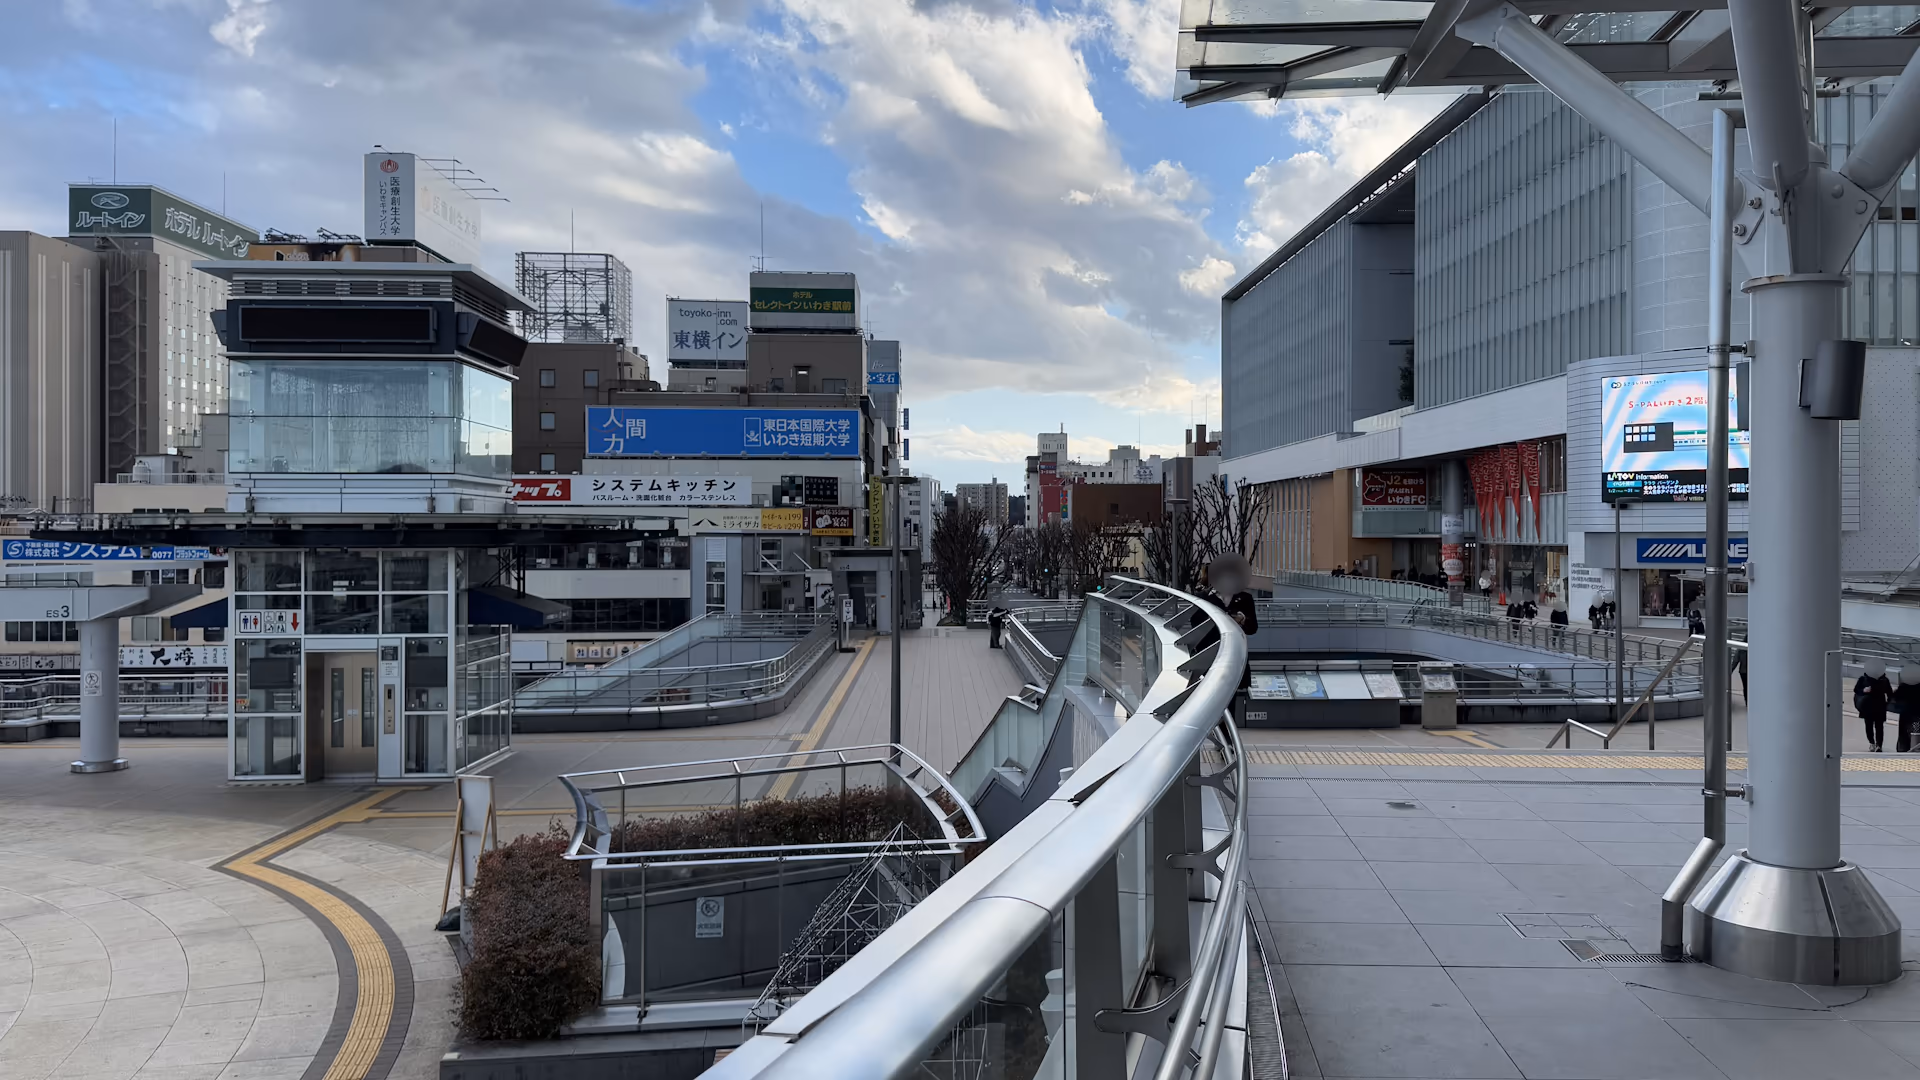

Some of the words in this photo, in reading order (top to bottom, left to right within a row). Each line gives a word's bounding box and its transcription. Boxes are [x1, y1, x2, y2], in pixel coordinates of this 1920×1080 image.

[379, 180, 387, 236] いわきキャンパス
[390, 176, 400, 236] 医療創生大学
[76, 211, 146, 228] ルートイン
[792, 291, 813, 299] ホテル
[679, 308, 732, 319] toyoko-inn
[673, 330, 744, 350] 東横イン
[764, 418, 851, 432] 東日本国際大学
[764, 433, 851, 447] いわき短期大学
[1528, 444, 1539, 487] BARGAIN
[592, 479, 736, 492] システムキッチン
[1387, 495, 1426, 504] いわきFC
[723, 520, 759, 529] ミライザカ
[25, 549, 60, 557] 株式会社
[62, 542, 138, 558] システム
